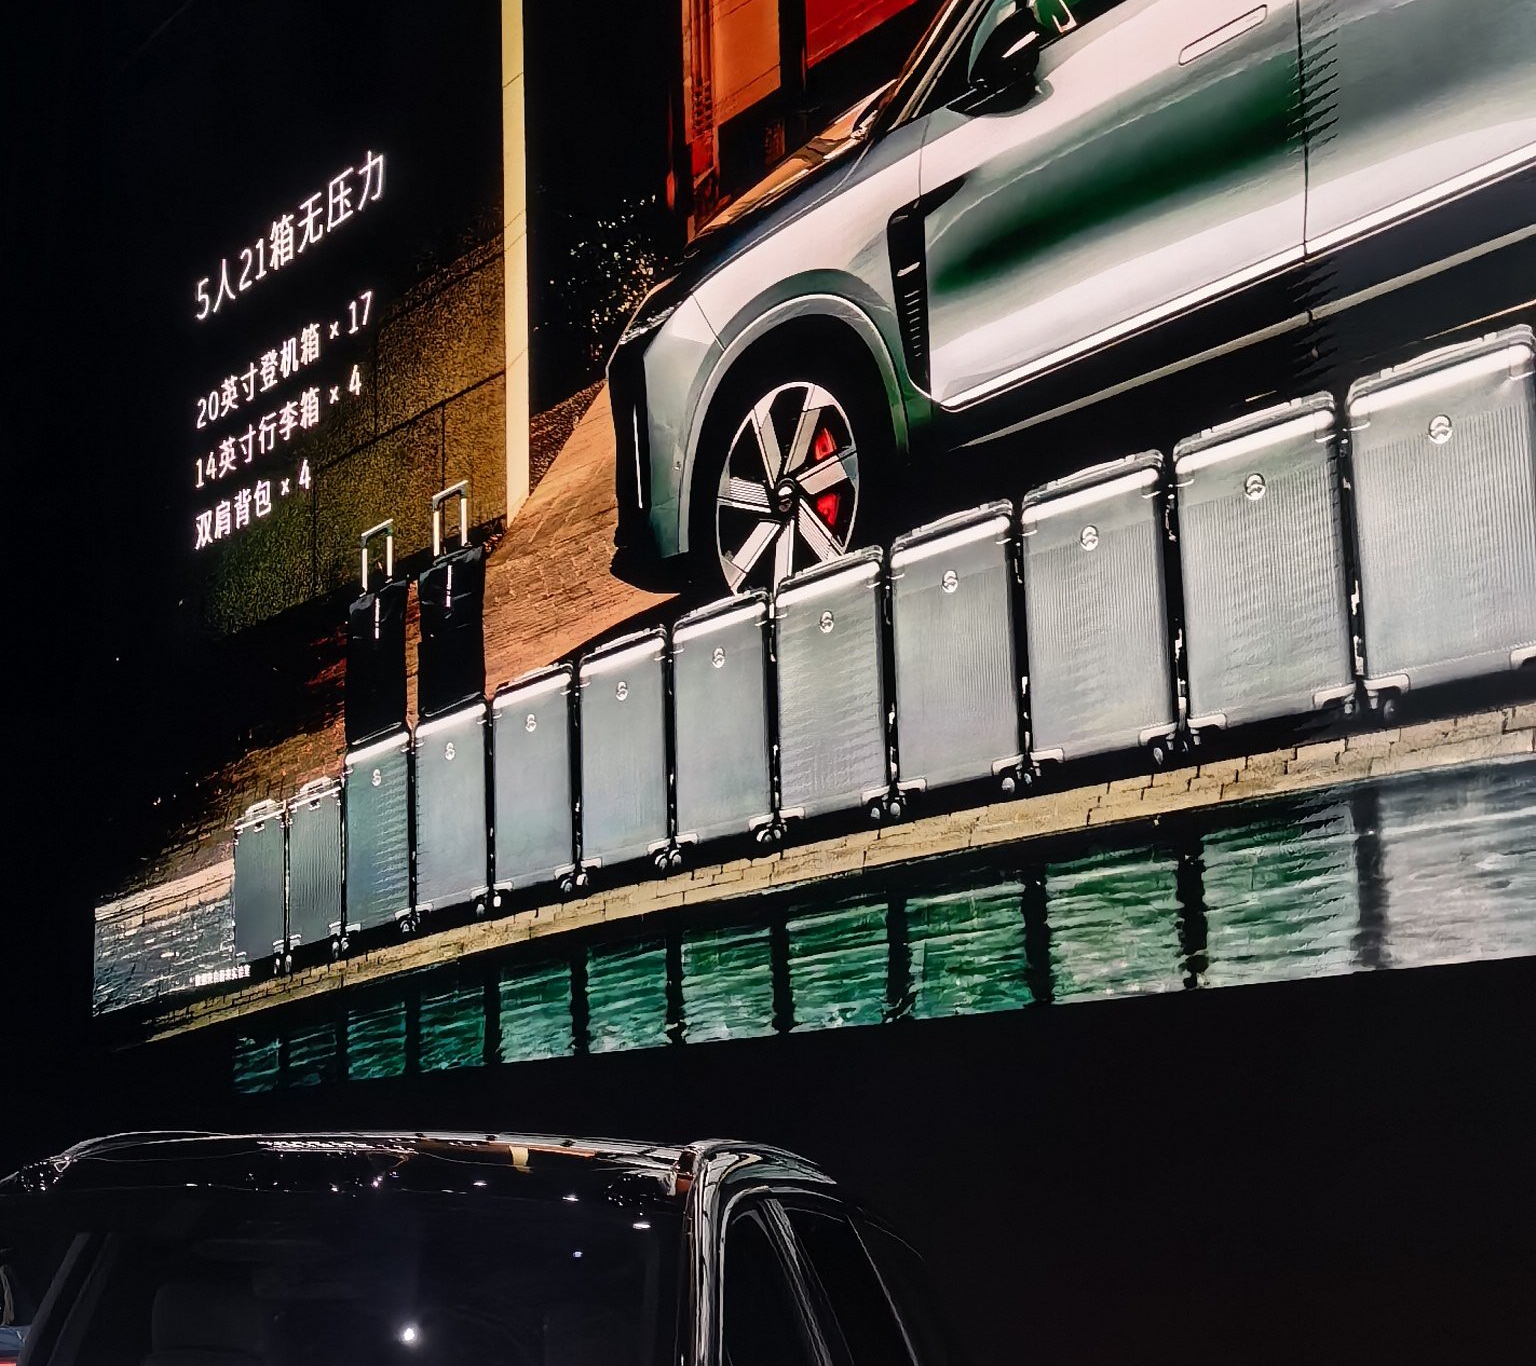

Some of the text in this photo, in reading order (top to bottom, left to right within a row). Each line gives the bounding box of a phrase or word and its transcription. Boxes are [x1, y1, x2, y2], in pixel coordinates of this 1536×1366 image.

[195, 150, 384, 321] 5人21箱无压力
[196, 322, 320, 429] 20英寸登机箱
[348, 290, 373, 335] 17
[195, 386, 320, 489] 14英寸行李箱
[348, 364, 363, 396] 4
[194, 479, 272, 551] 双肩背包
[298, 459, 312, 490] 4
